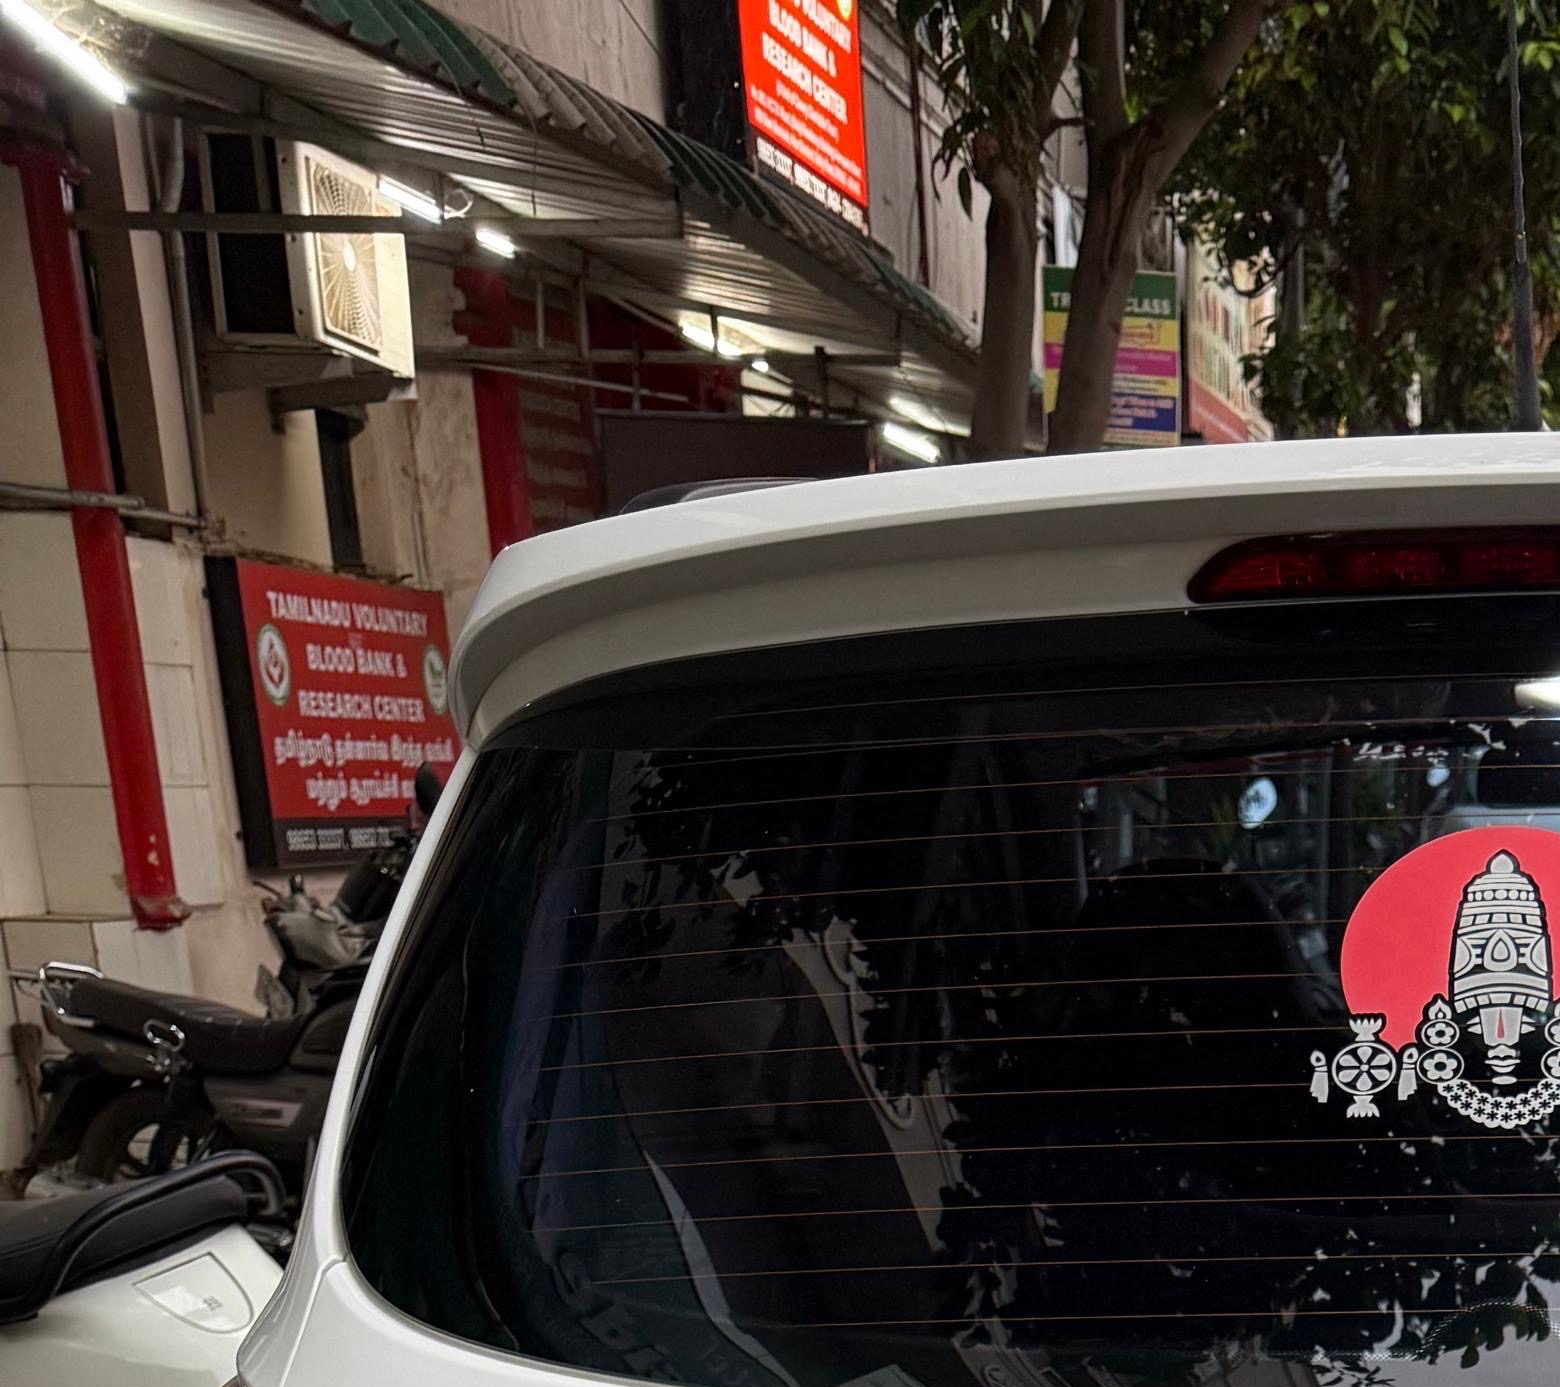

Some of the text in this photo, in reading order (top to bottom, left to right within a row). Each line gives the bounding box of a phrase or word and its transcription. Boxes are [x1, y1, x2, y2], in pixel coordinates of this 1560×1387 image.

[266, 591, 428, 638] TAMILNADU VOLUNTARY
[305, 643, 408, 679] BLOOD BANK &
[297, 689, 426, 722] RESEARCH CENTER
